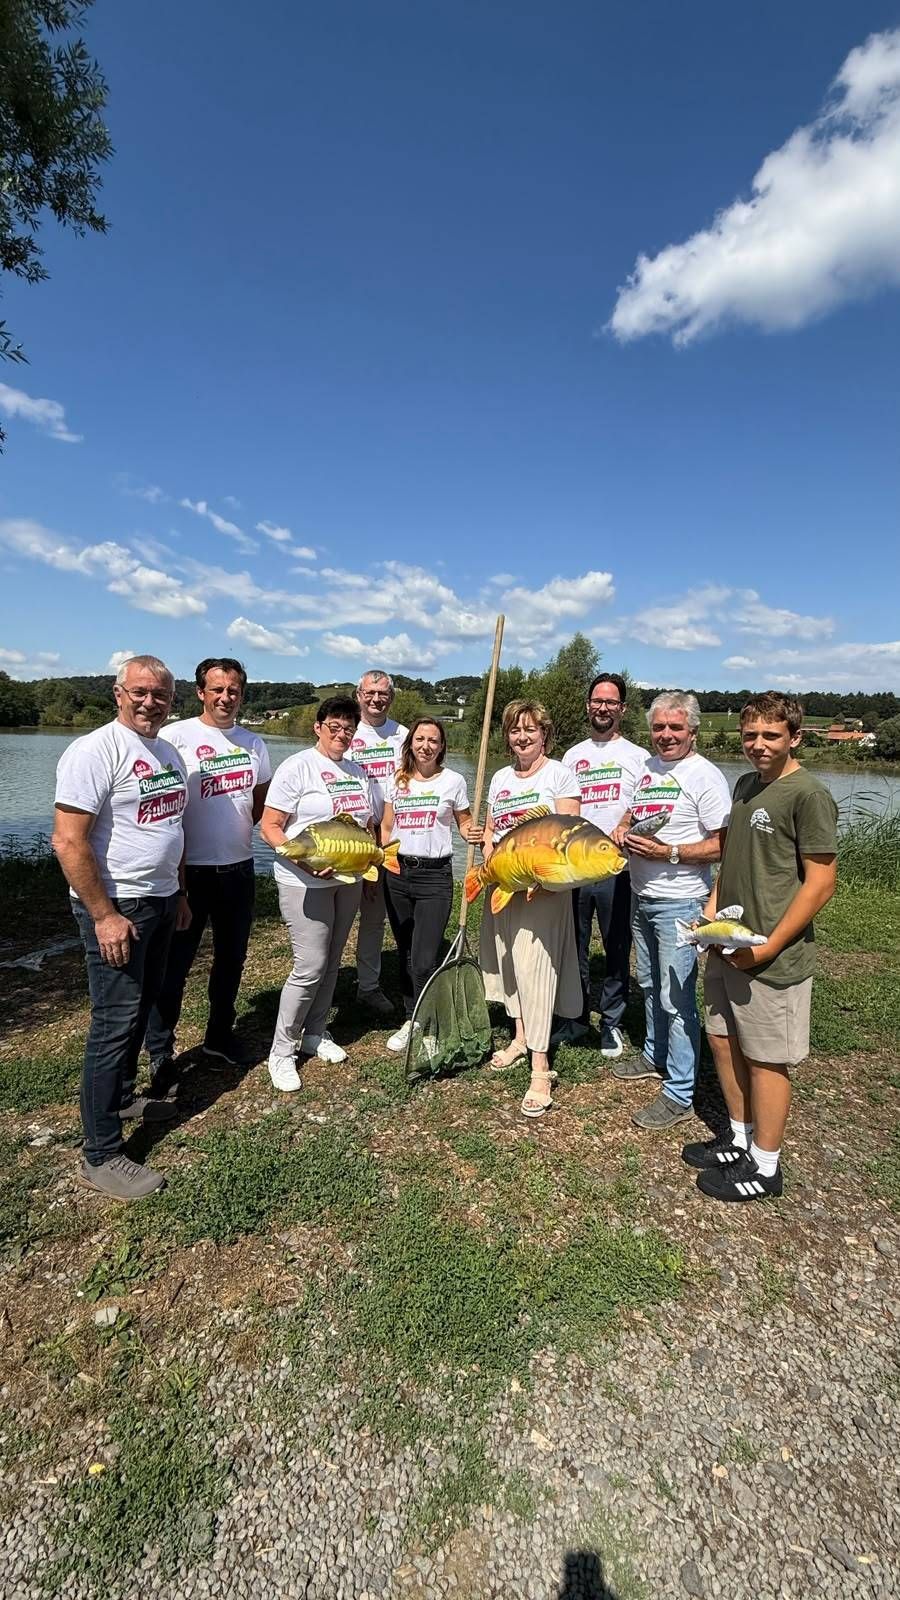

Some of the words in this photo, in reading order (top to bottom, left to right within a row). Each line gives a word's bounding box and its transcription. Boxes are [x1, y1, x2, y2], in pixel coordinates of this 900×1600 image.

[201, 757, 250, 771] Bäuerinnen
[202, 771, 252, 799] Zukunft
[139, 791, 184, 824] Zukunft
